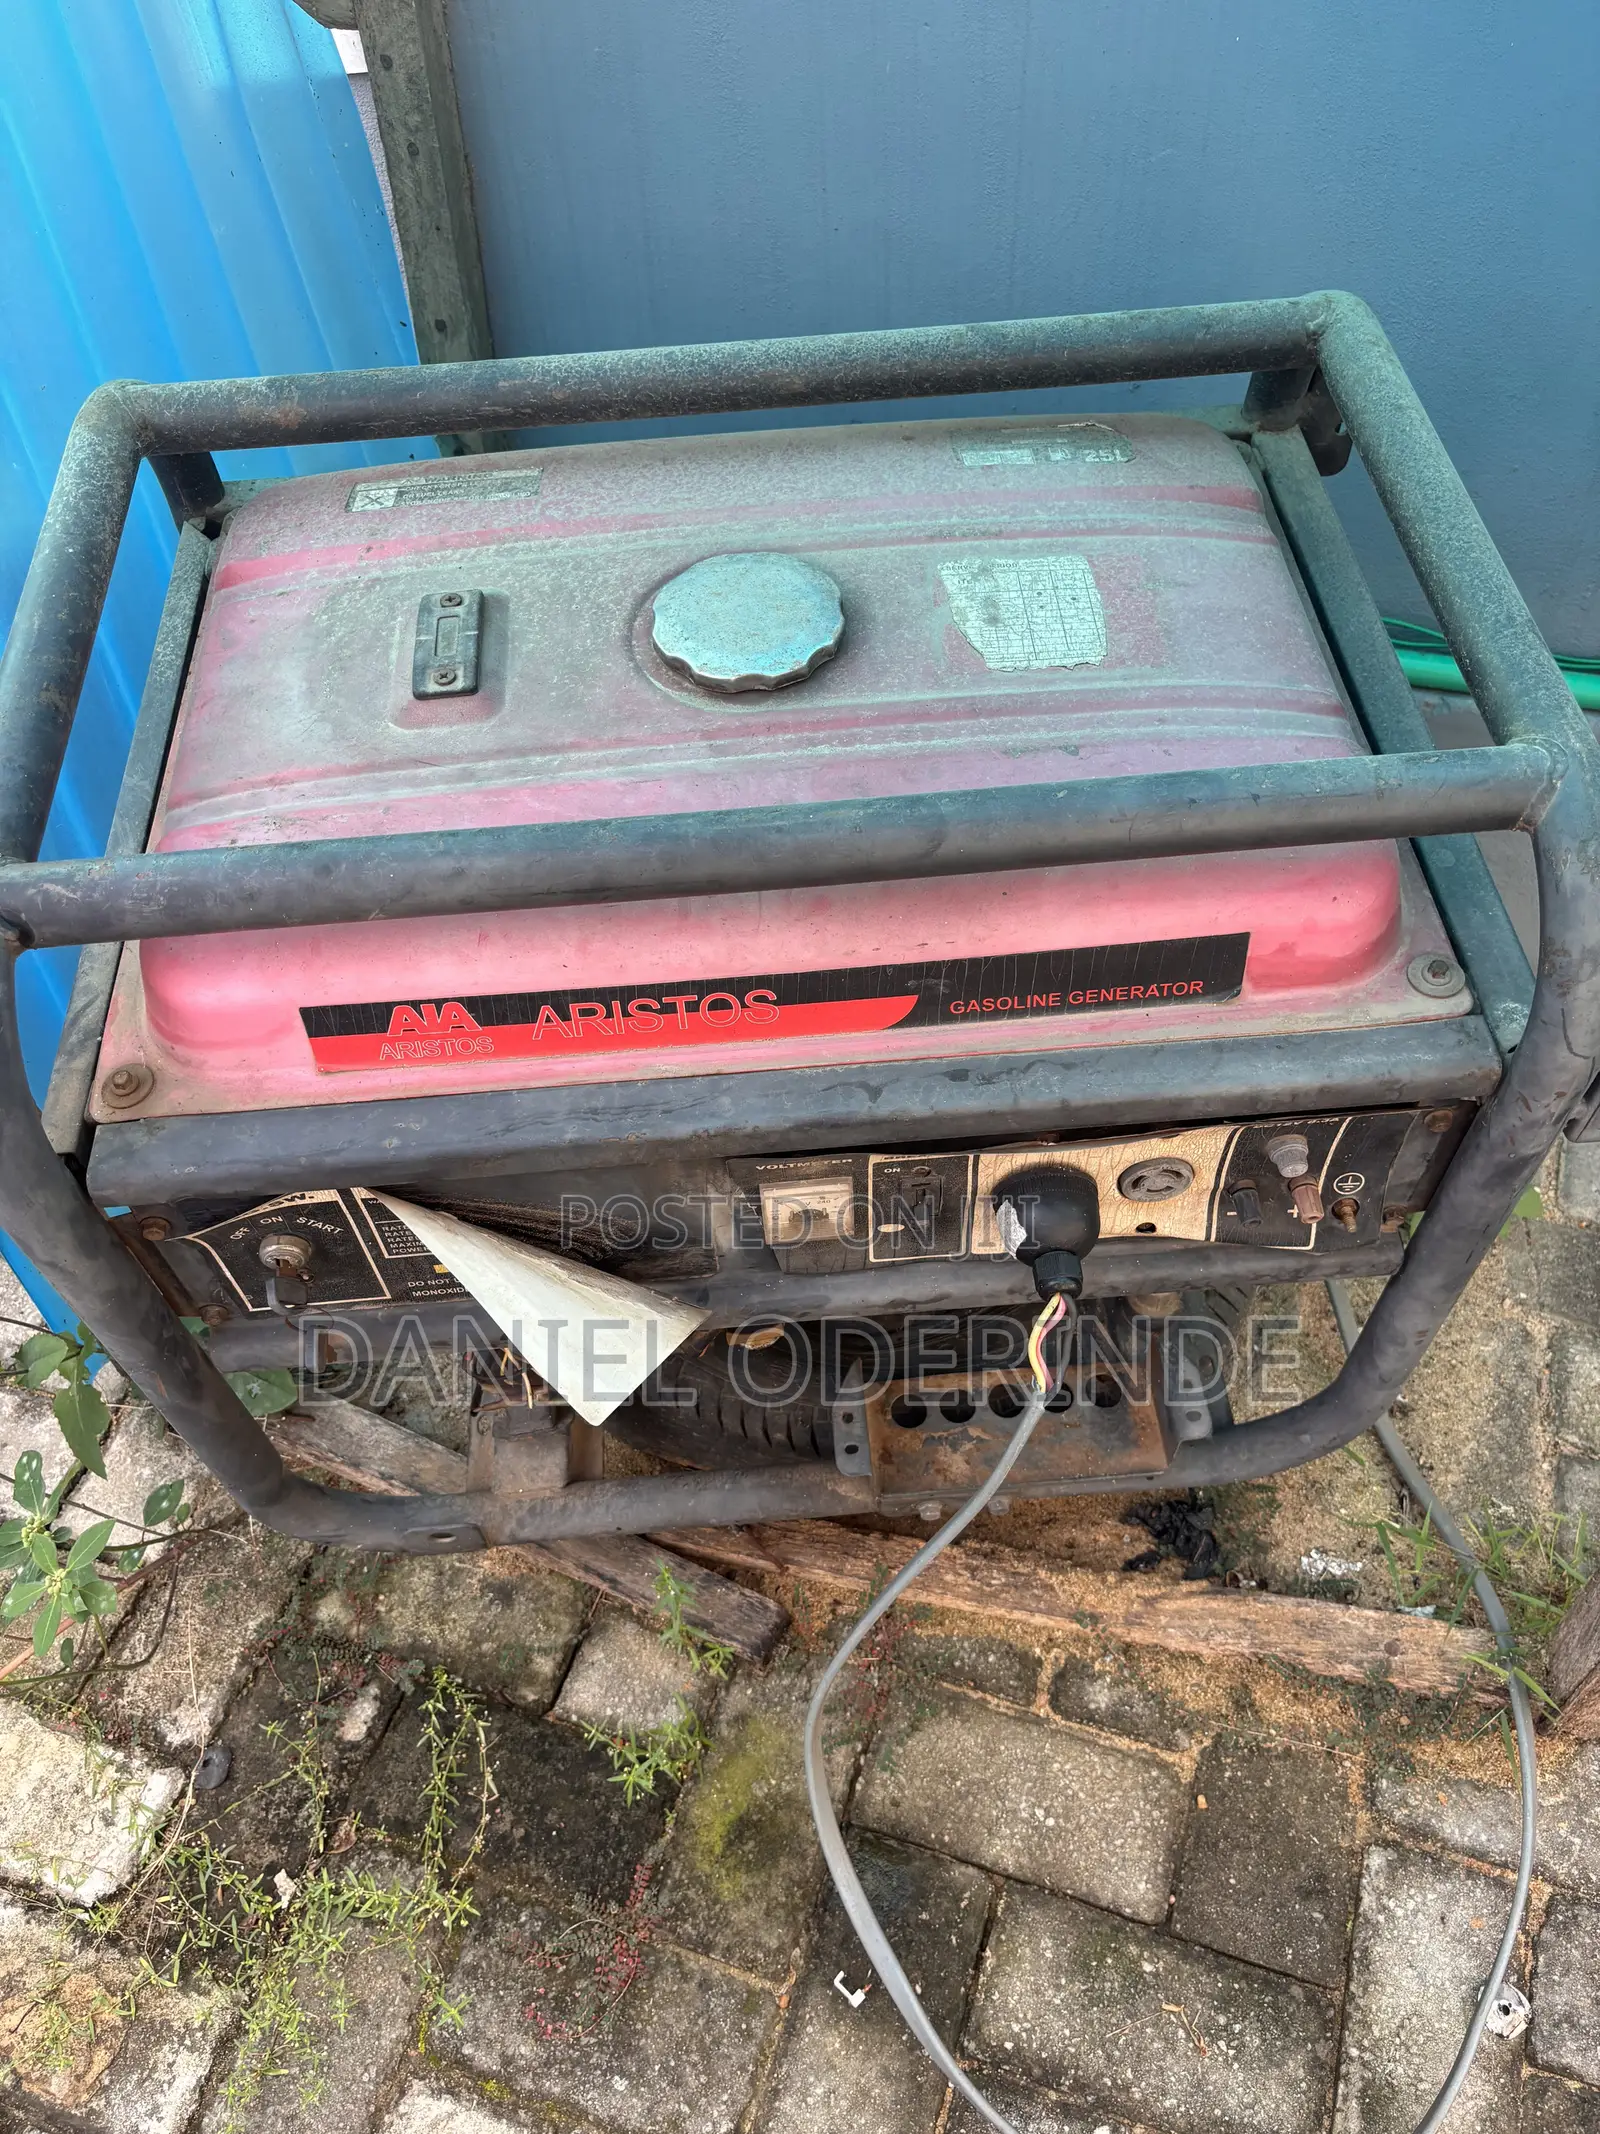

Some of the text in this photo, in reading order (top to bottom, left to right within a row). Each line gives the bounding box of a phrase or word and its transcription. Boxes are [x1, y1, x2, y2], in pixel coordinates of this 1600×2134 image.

[950, 980, 1205, 1015] GASOLINE GENERATOR
[532, 989, 780, 1041] ARISTOS
[379, 1036, 495, 1061] ARISTOS
[755, 1158, 853, 1171] VOLTMETER
[260, 1215, 284, 1225] ON
[296, 1216, 345, 1235] START
[230, 1227, 250, 1240] OFF
[407, 1280, 425, 1288] DO
[427, 1278, 450, 1286] NOT
